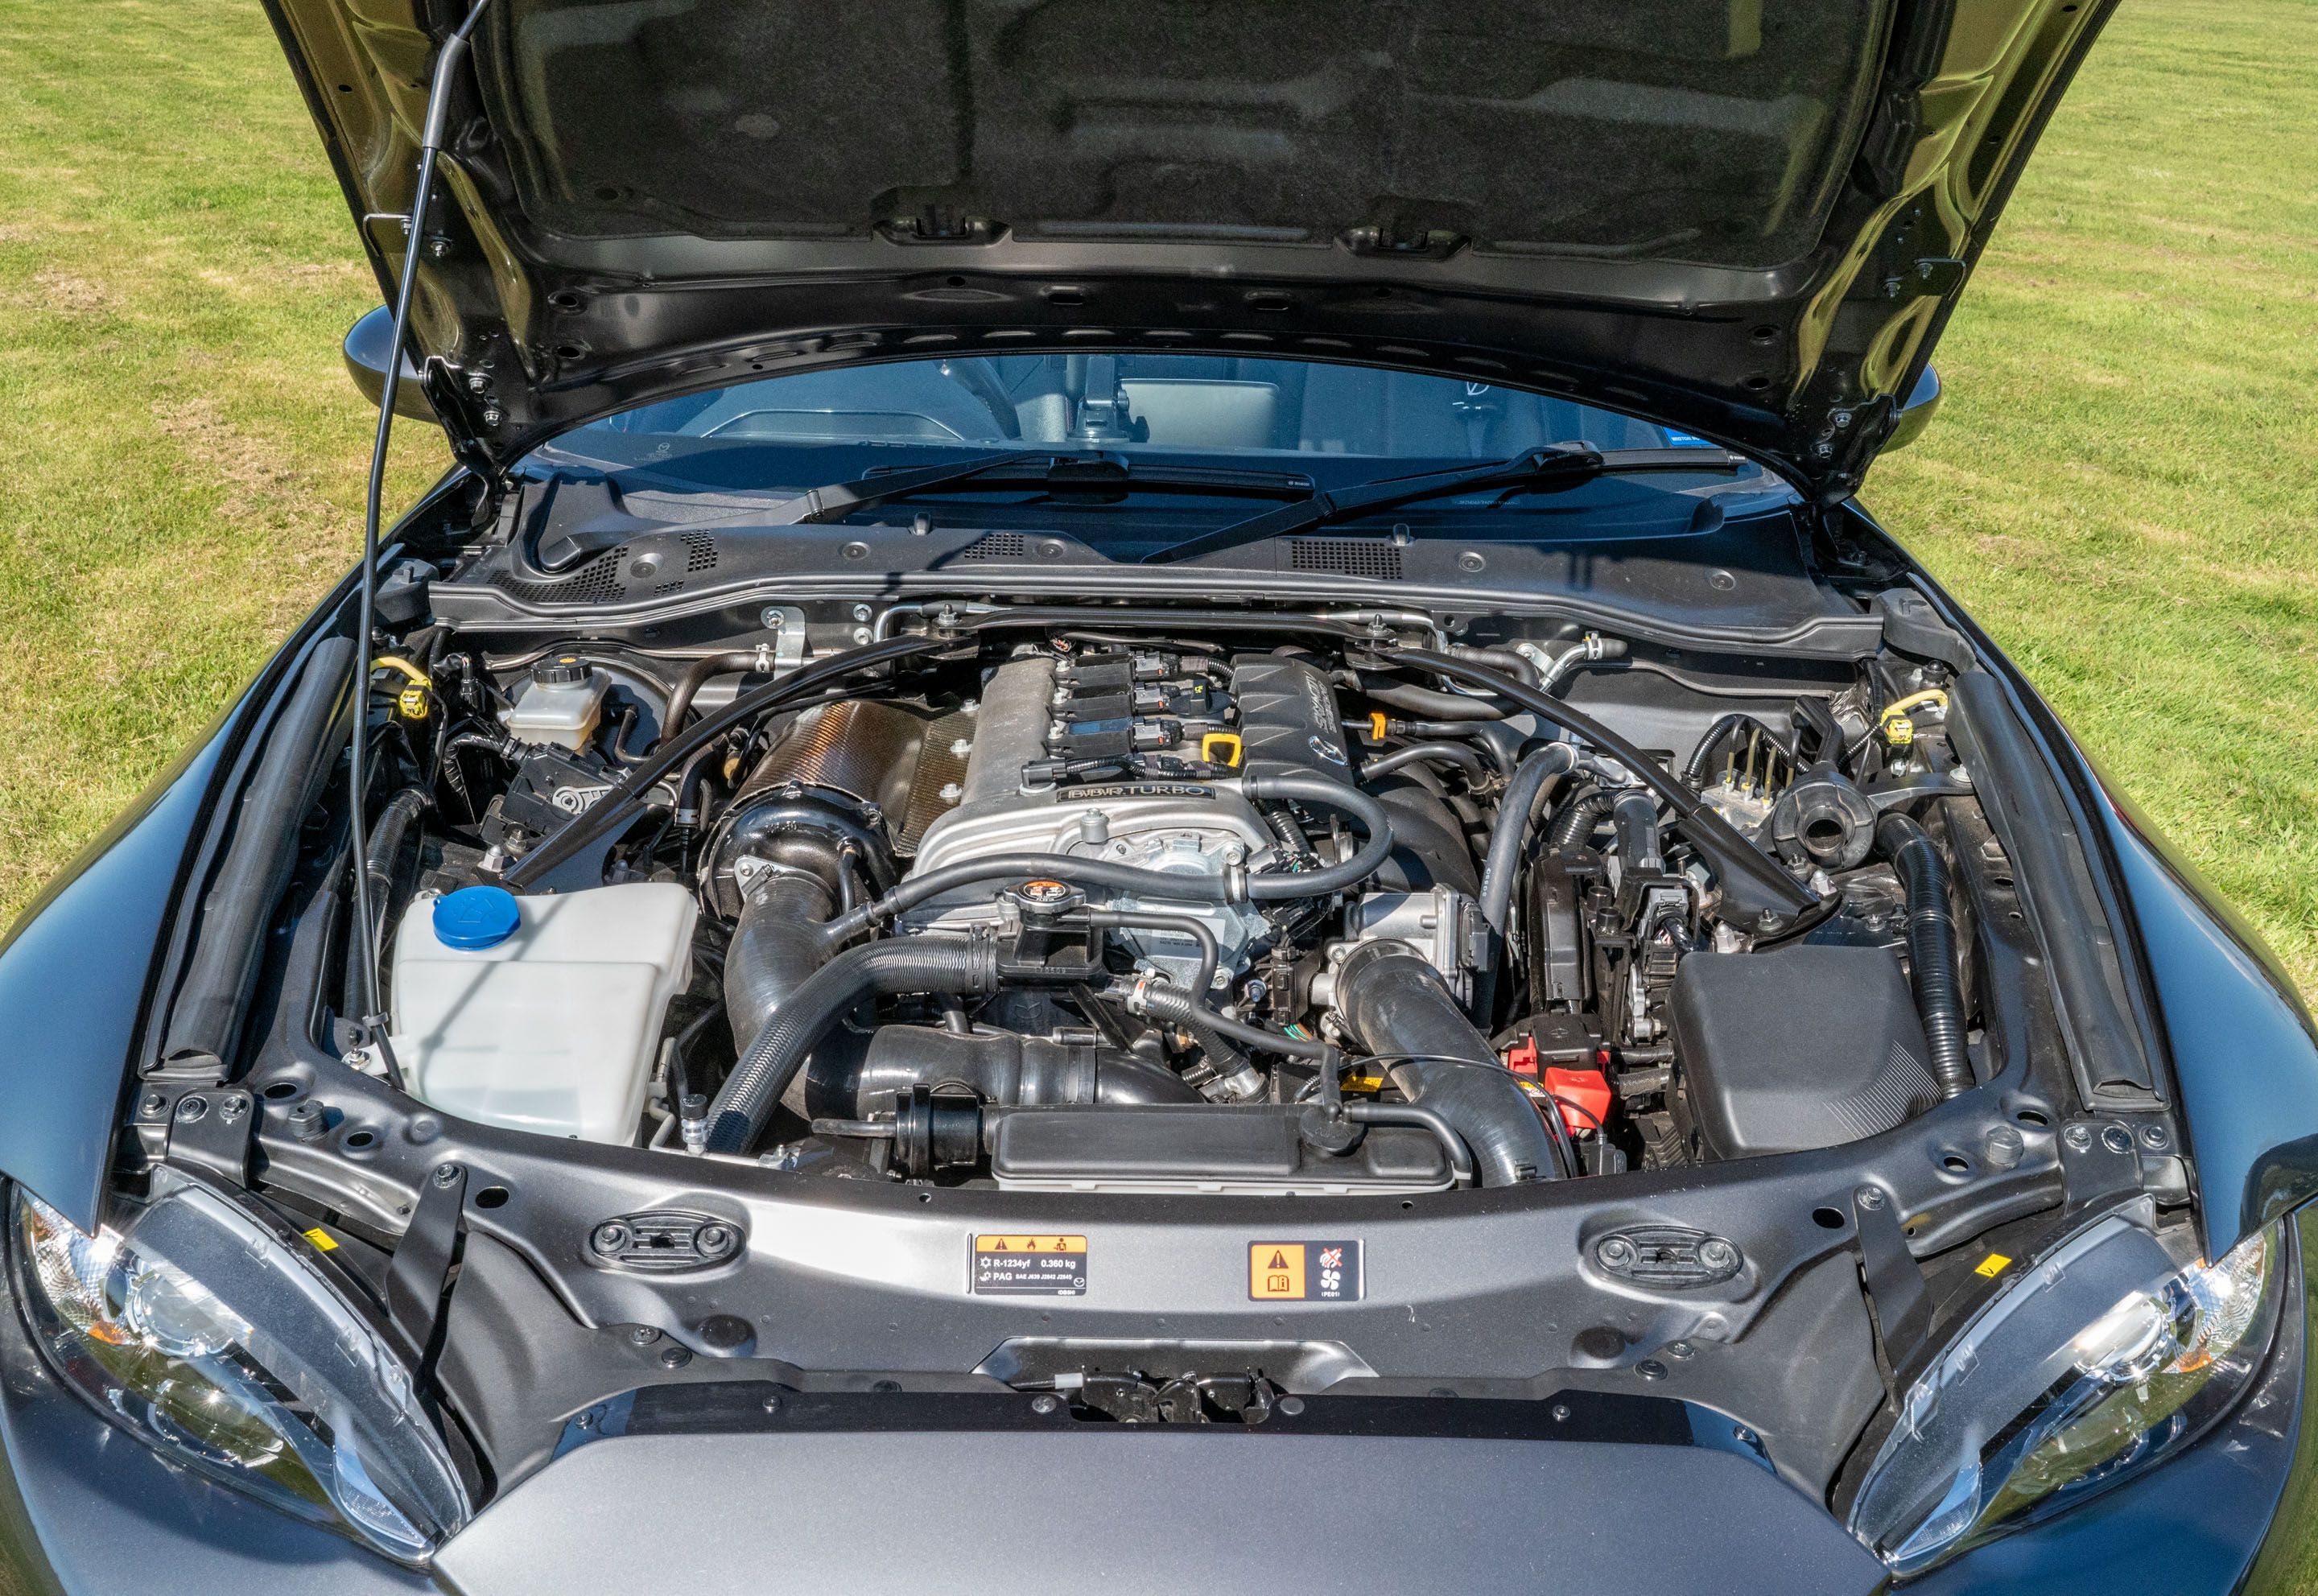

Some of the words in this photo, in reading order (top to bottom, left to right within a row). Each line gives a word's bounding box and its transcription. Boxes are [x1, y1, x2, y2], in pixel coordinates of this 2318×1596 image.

[993, 1259, 1031, 1269] R-1234yf
[1041, 1259, 1064, 1268] 0.360
[1065, 1259, 1076, 1270] kg
[993, 1272, 1013, 1281] PAG
